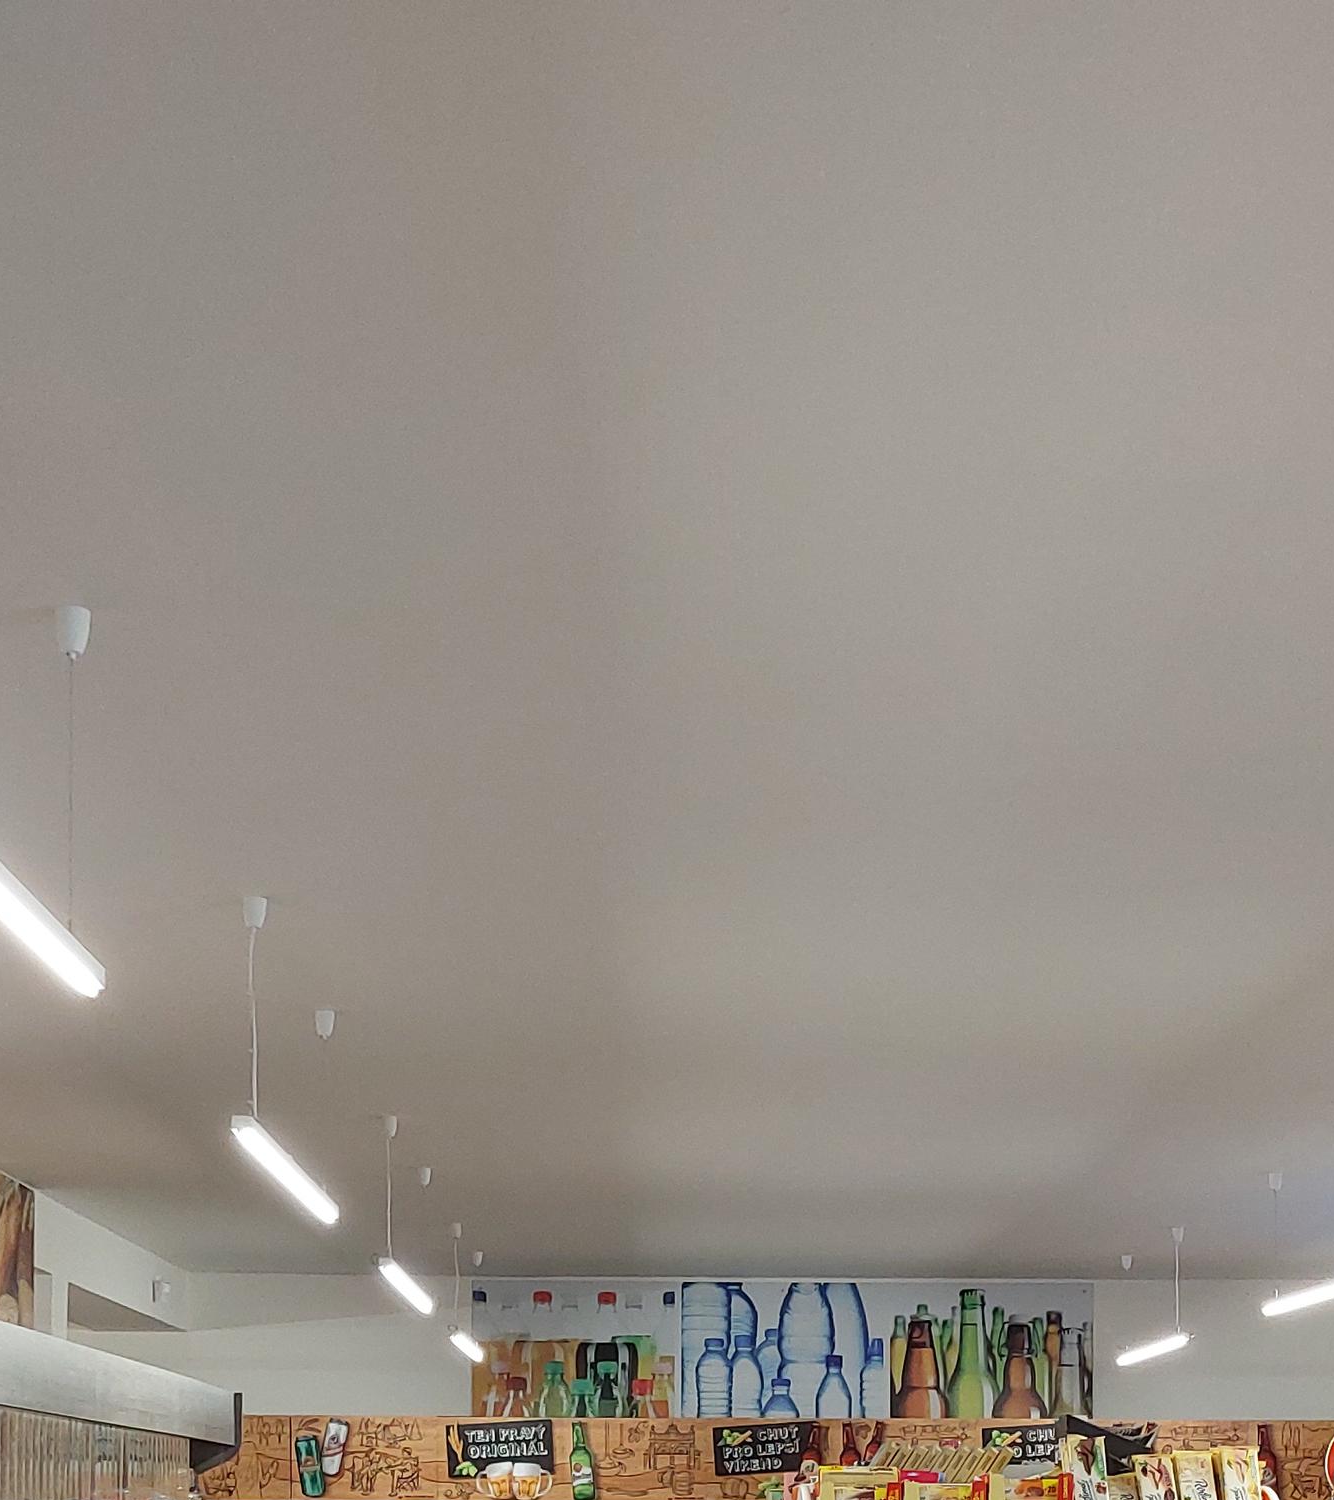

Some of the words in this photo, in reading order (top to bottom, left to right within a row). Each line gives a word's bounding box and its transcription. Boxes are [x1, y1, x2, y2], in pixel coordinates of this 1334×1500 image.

[464, 1429, 495, 1443] TEN
[1026, 1428, 1056, 1442] CHU
[722, 1445, 753, 1459] PRO
